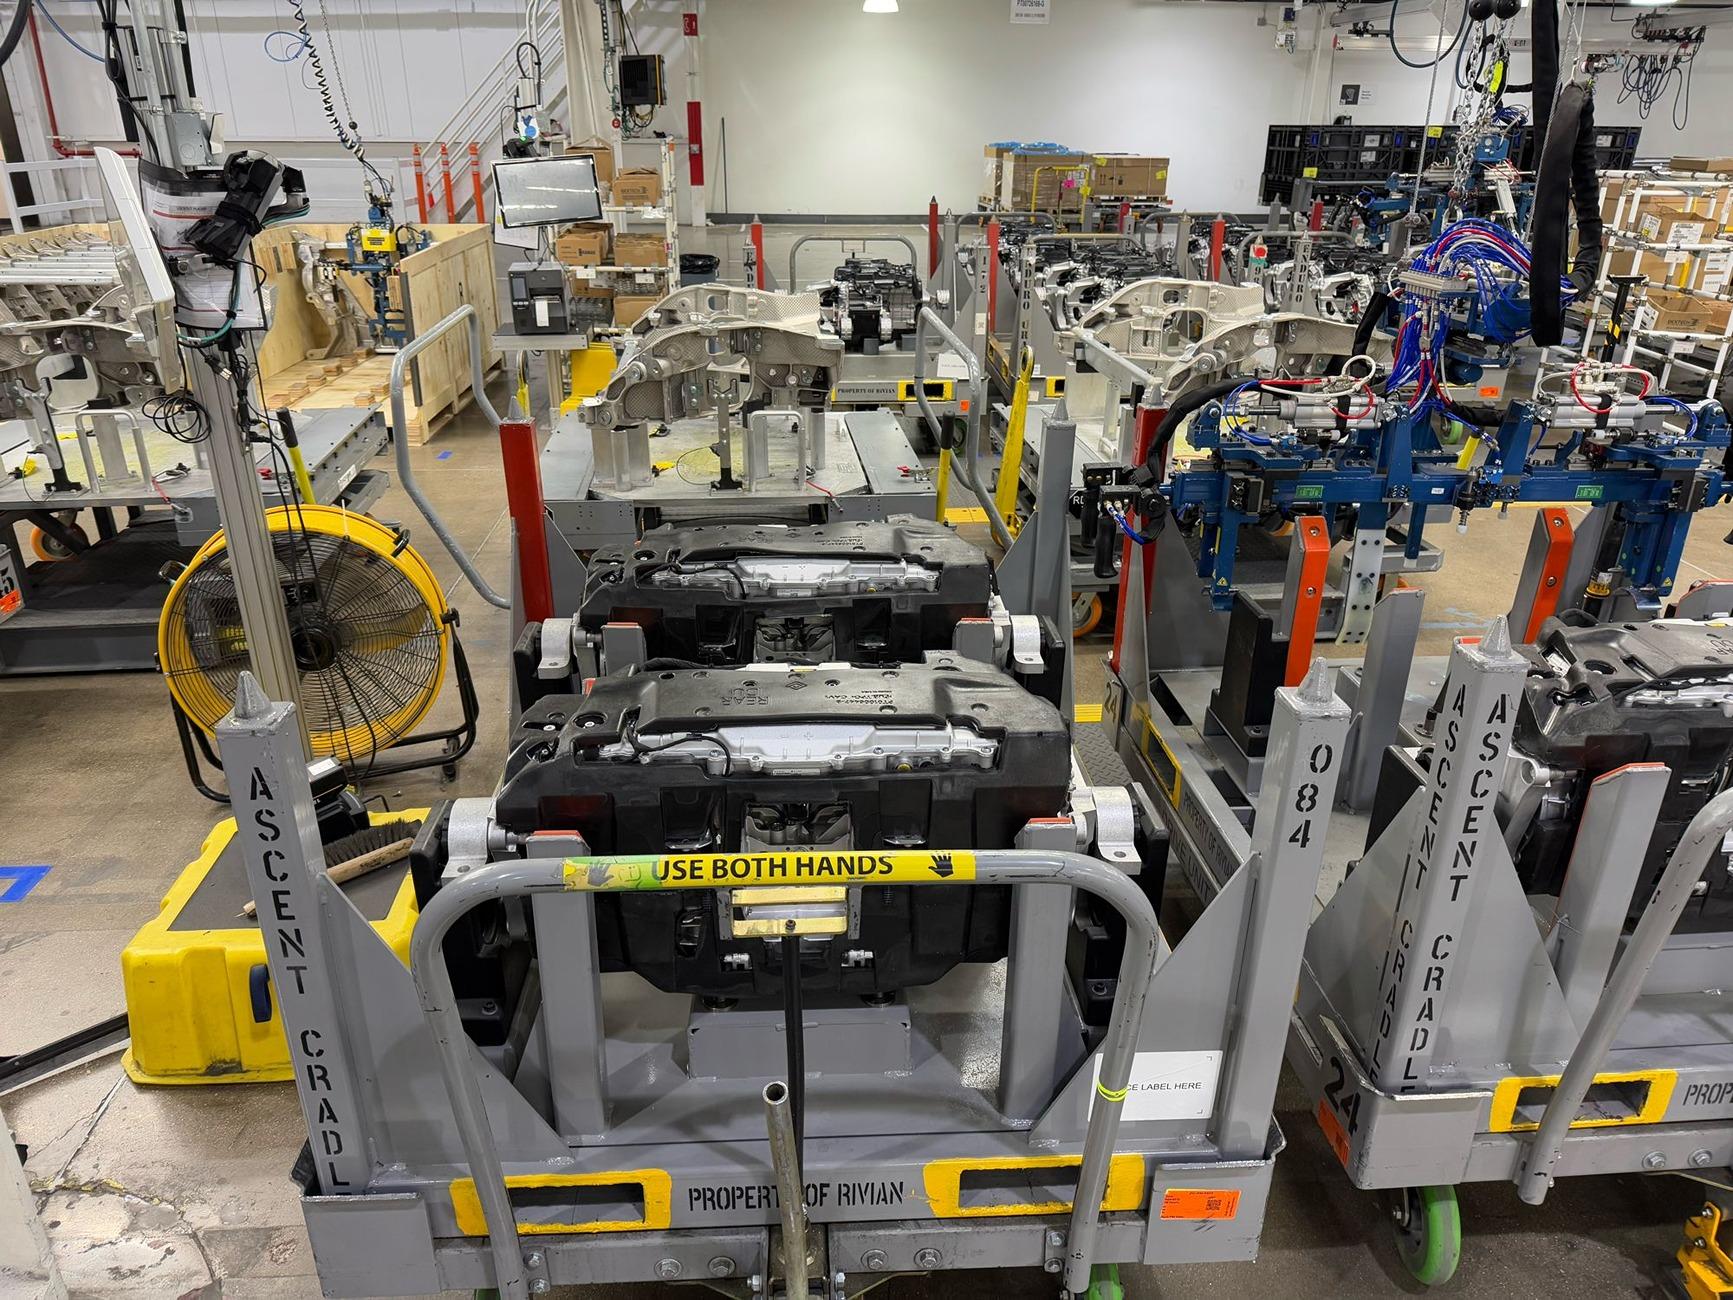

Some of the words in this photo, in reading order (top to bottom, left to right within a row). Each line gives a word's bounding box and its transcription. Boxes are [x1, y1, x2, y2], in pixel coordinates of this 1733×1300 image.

[1295, 244, 1310, 303] ENDURO
[719, 696, 770, 706] REAR
[1288, 743, 1333, 849] 084
[1415, 683, 1466, 890] ASCENT
[1449, 693, 1509, 902] ASCENT
[249, 766, 308, 995] ASCENT
[653, 860, 704, 881] USE
[712, 858, 788, 879] BOTH
[796, 855, 894, 877] HANDS
[300, 1028, 354, 1196] CRADL
[1141, 1082, 1172, 1091] LABEL
[1174, 1081, 1203, 1090] HERE
[1324, 1056, 1361, 1137] 24
[688, 1184, 779, 1212] PROPERT
[805, 1183, 831, 1208] OF
[838, 1181, 904, 1207] RIVIAN
